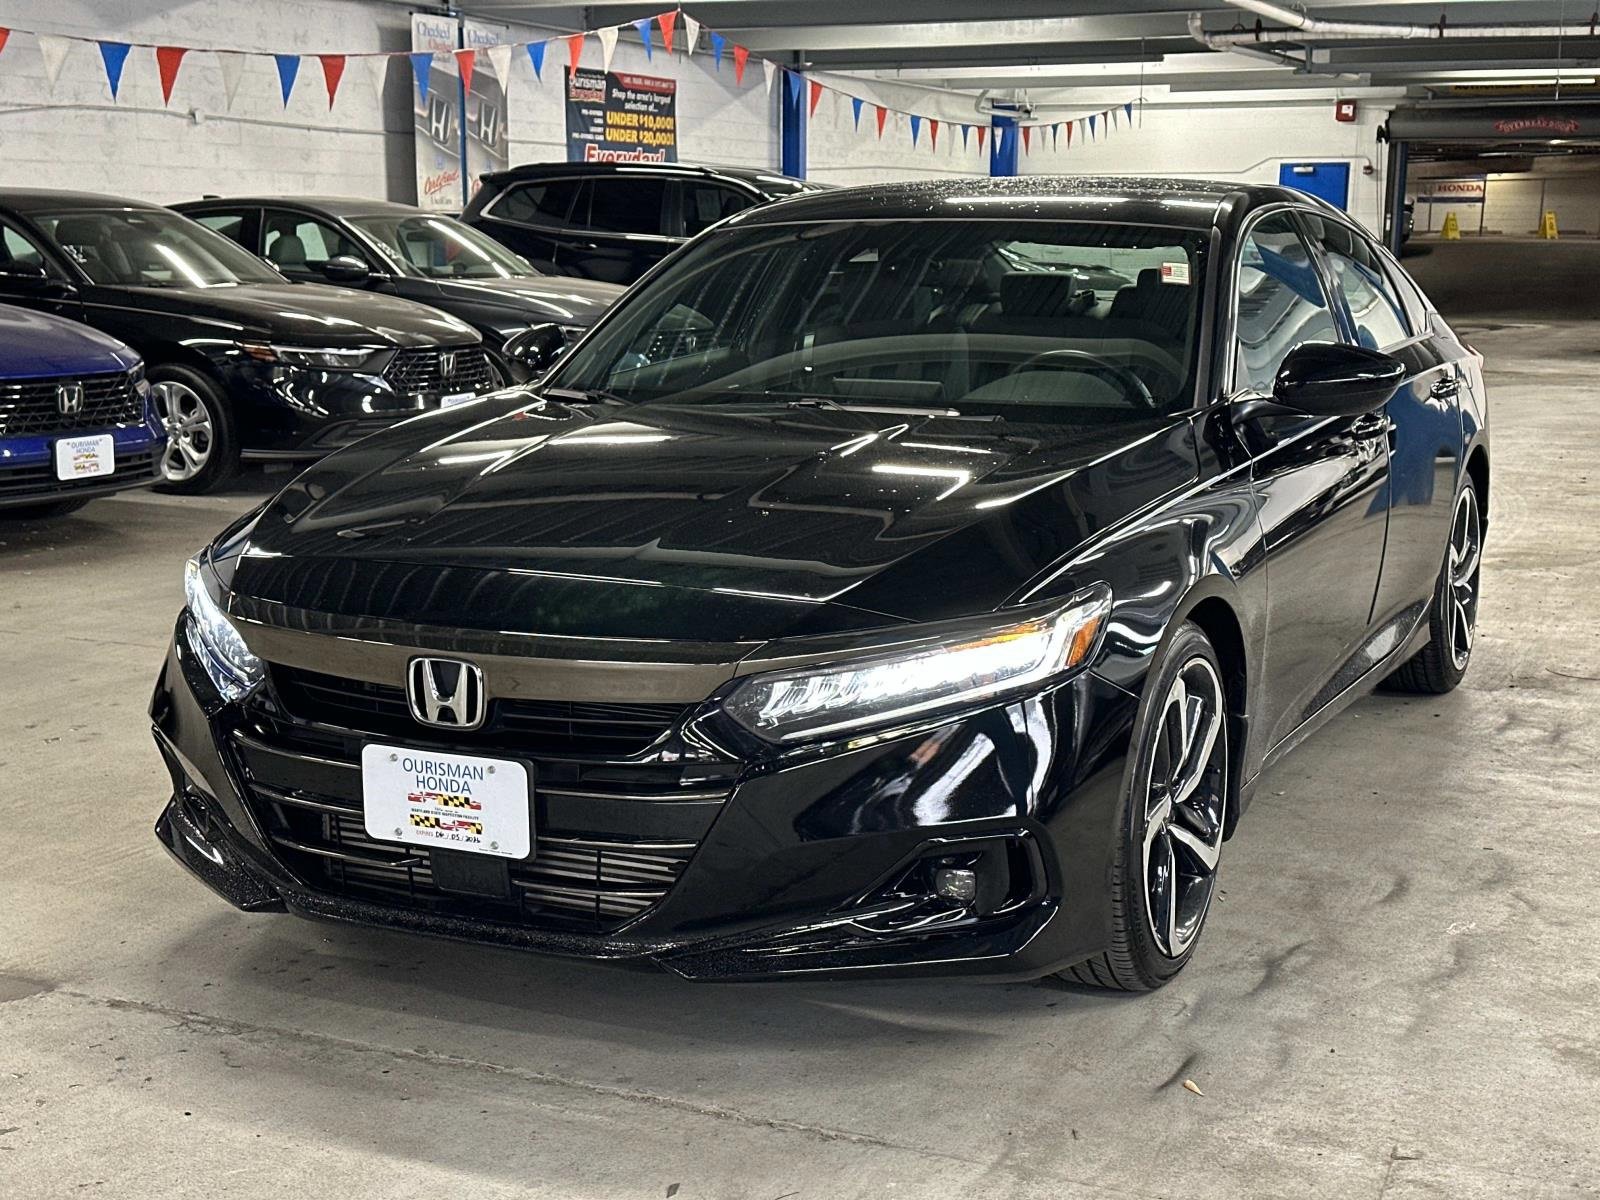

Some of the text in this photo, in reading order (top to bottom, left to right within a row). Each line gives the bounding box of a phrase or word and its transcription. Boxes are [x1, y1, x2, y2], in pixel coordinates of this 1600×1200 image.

[606, 111, 674, 131] UNDER $10,000!
[605, 127, 674, 148] UNDER $20,000!
[1437, 184, 1483, 193] HONDA
[402, 757, 484, 781] OURISMAN
[416, 775, 472, 795] HONDA
